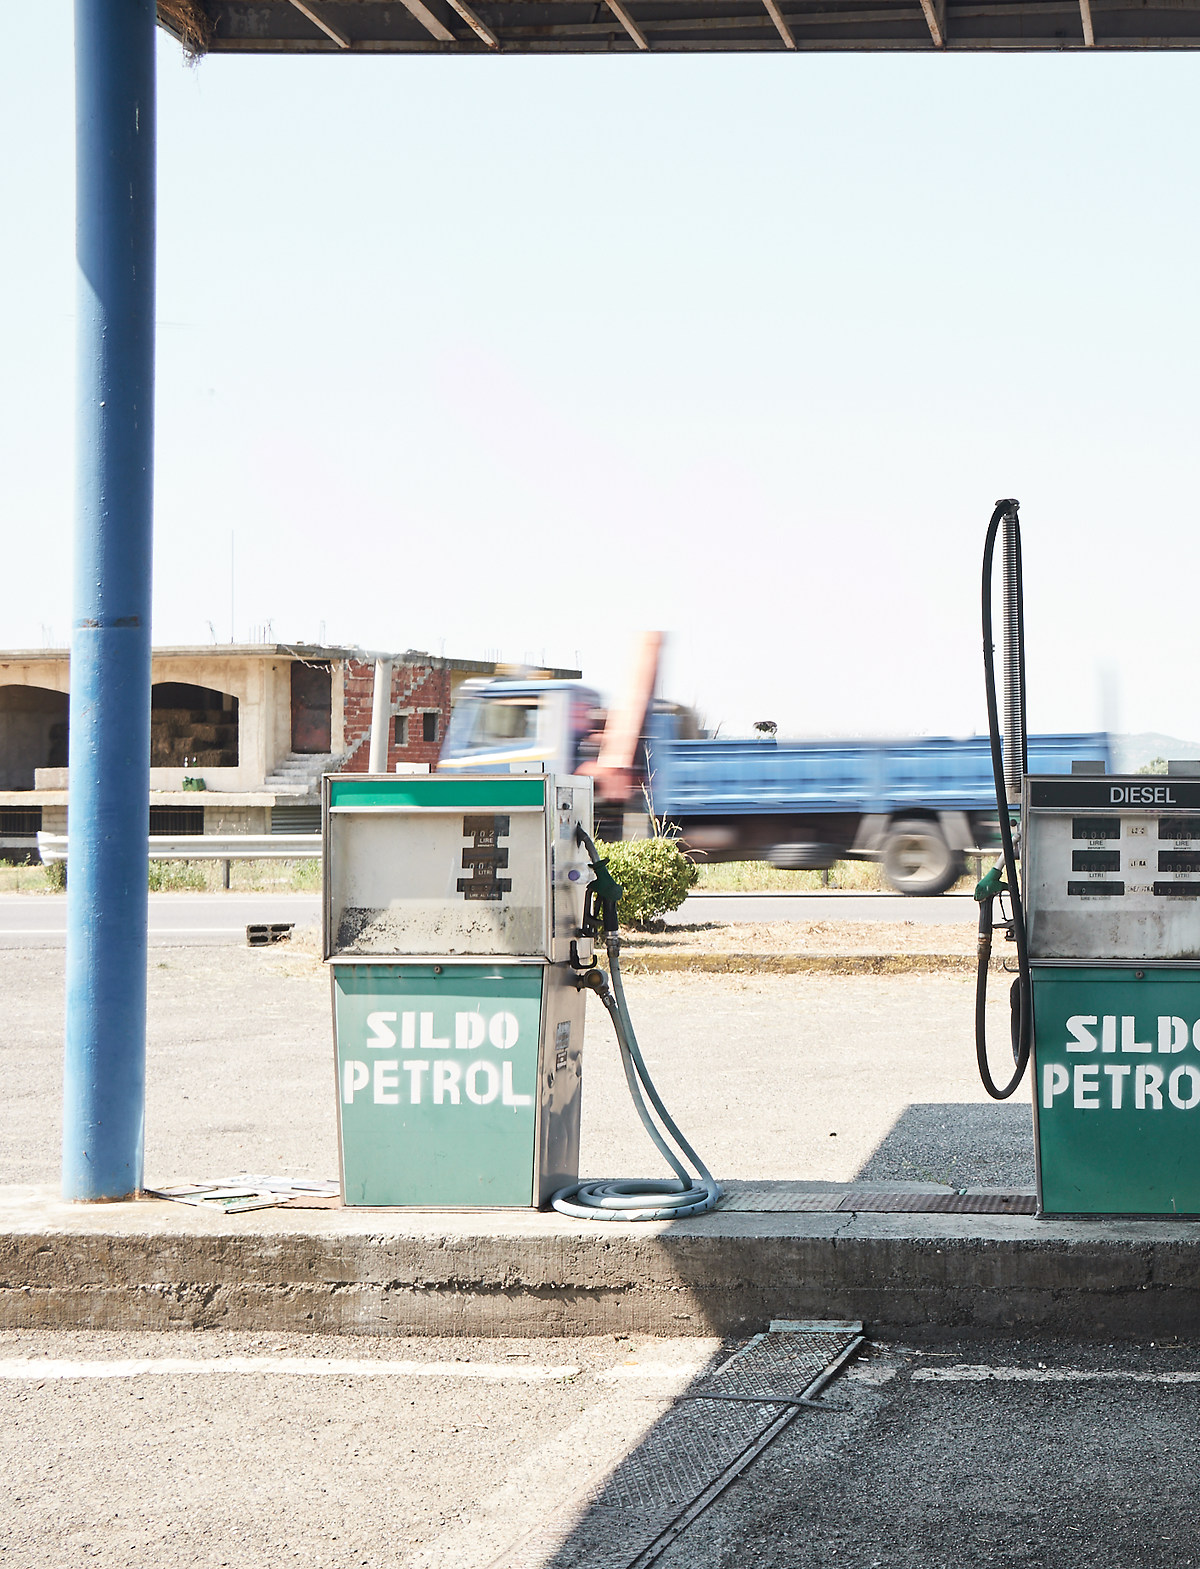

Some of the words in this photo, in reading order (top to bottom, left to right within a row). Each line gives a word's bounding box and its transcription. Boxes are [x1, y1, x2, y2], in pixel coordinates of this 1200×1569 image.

[1110, 786, 1177, 804] DIESEL
[366, 1011, 520, 1049] SILDO
[343, 1059, 532, 1107] PETROL
